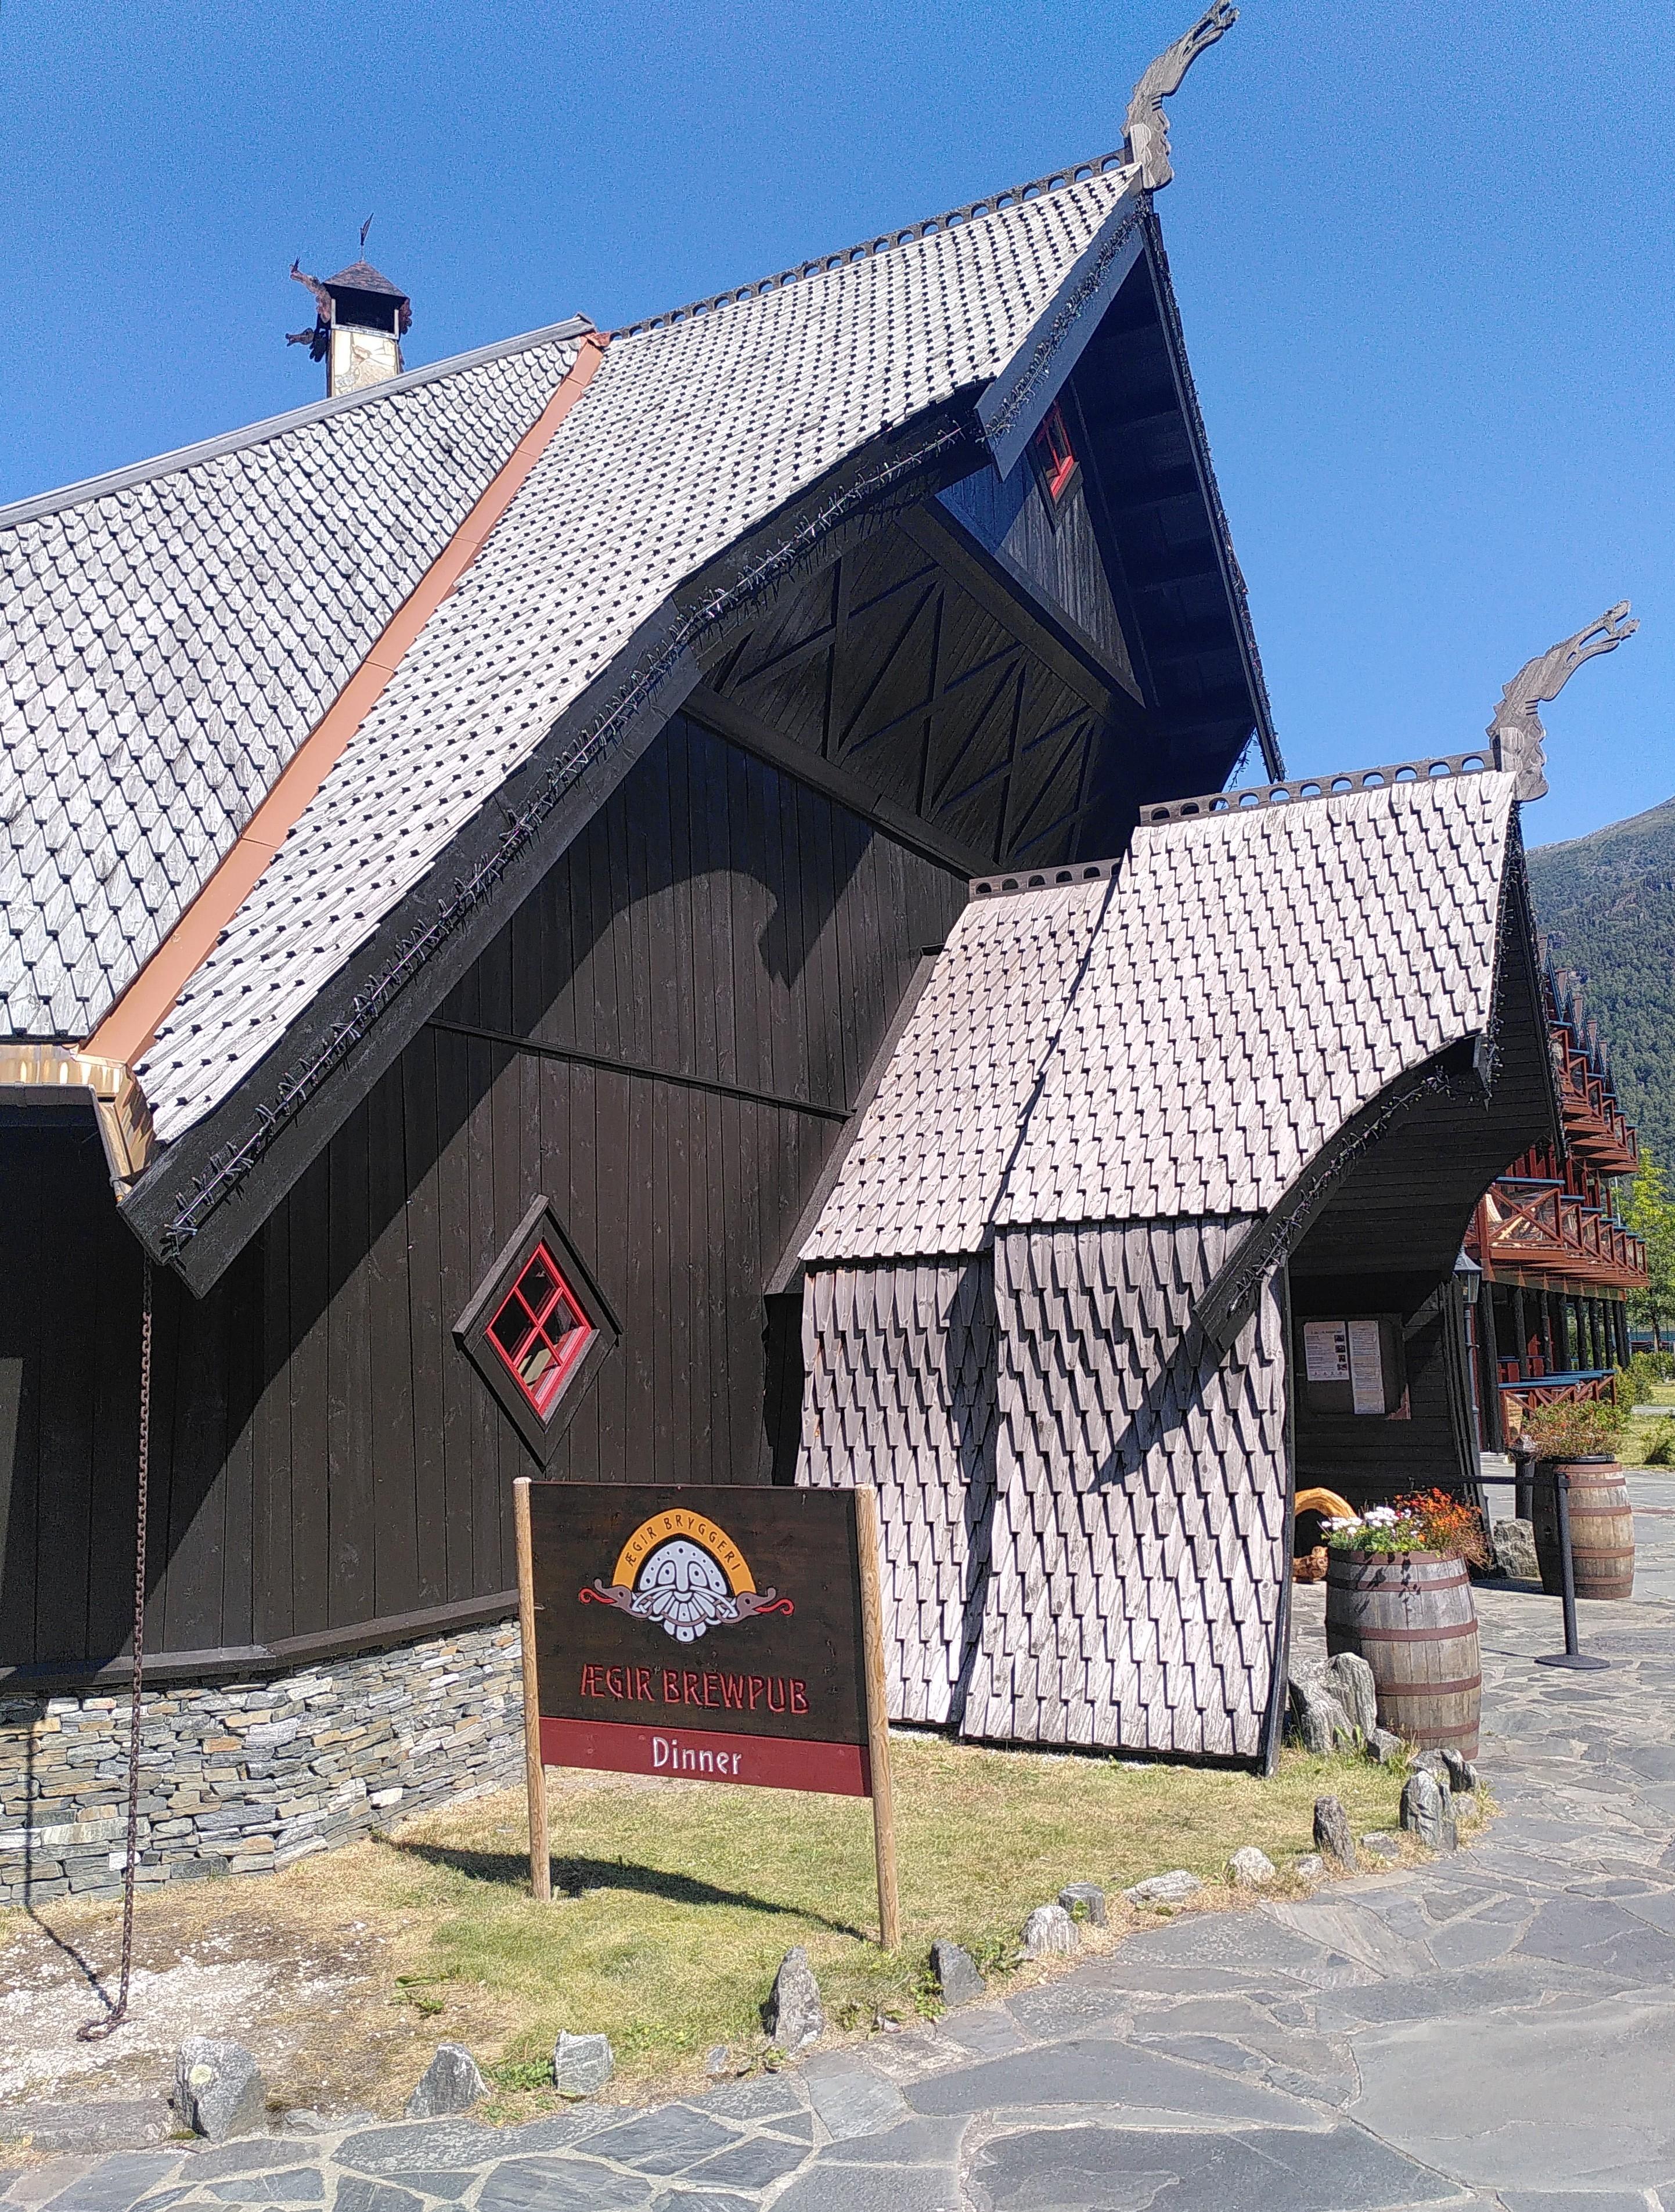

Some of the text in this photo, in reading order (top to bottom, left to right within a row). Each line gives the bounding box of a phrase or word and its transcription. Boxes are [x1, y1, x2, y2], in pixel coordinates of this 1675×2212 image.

[625, 1515, 741, 1570] ÆGIR BRYGGERI
[581, 1663, 809, 1714] ÆGIR BREWPUB
[653, 1736, 742, 1774] Dinner
